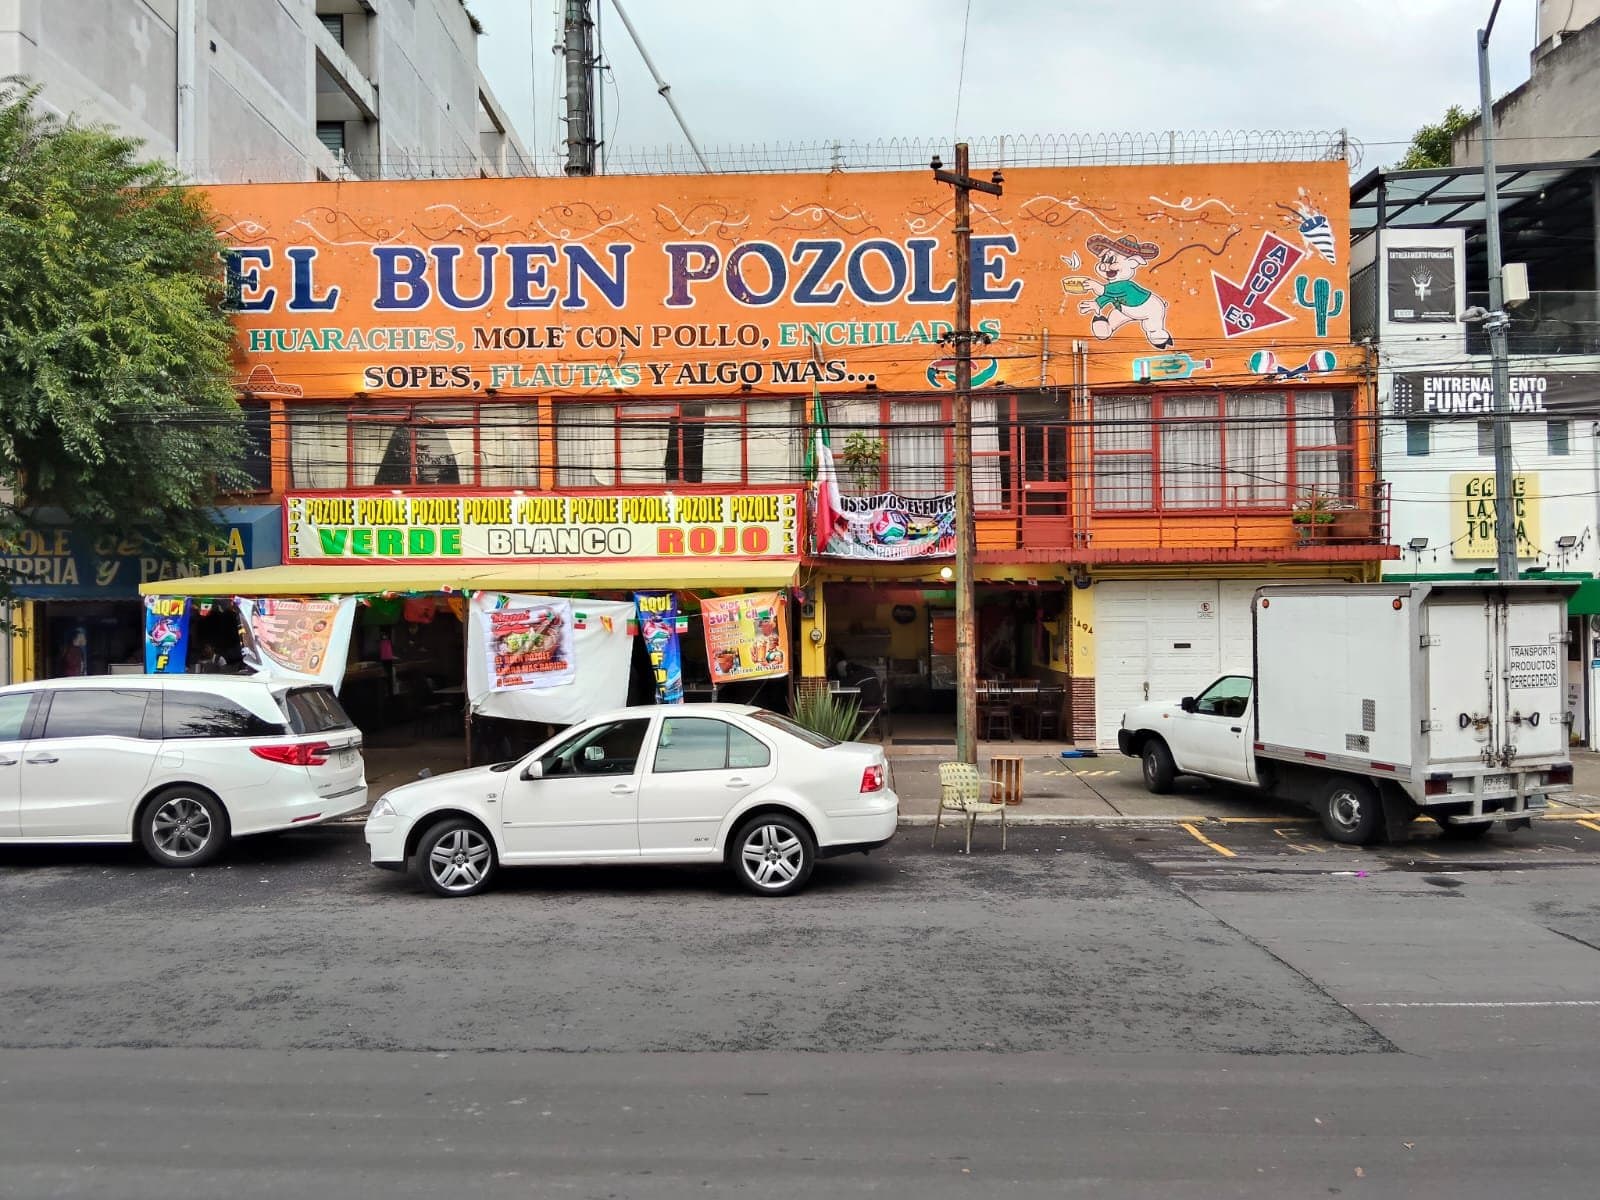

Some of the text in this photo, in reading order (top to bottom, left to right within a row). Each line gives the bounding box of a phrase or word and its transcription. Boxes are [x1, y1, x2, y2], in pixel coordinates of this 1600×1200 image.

[221, 234, 1024, 313] EL BUEN POZOLE
[1243, 243, 1289, 309] AQUI
[1223, 303, 1256, 330] ES
[247, 317, 1001, 354] HUARACHES, MOLE CON POLLO, ENCHILADS
[364, 358, 876, 391] SOPES, FLAUTAS Y ALGO MAS...
[1424, 376, 1547, 392] ENTRENAENTO
[1424, 393, 1547, 413] FUNCINAL
[1466, 478, 1526, 496] CAE
[305, 496, 779, 525] POZOLE POZOLE POZOLE POZOLE POZOLE POZOLE POZOLE POZOLE POZOLE
[923, 495, 957, 515] FUTB
[318, 526, 769, 556] VERDE BLANCO ROJO
[1511, 647, 1556, 657] TRANSPORTA
[1511, 660, 1556, 671] PRODUCTOS
[1511, 673, 1557, 687] PERECEDEROS
